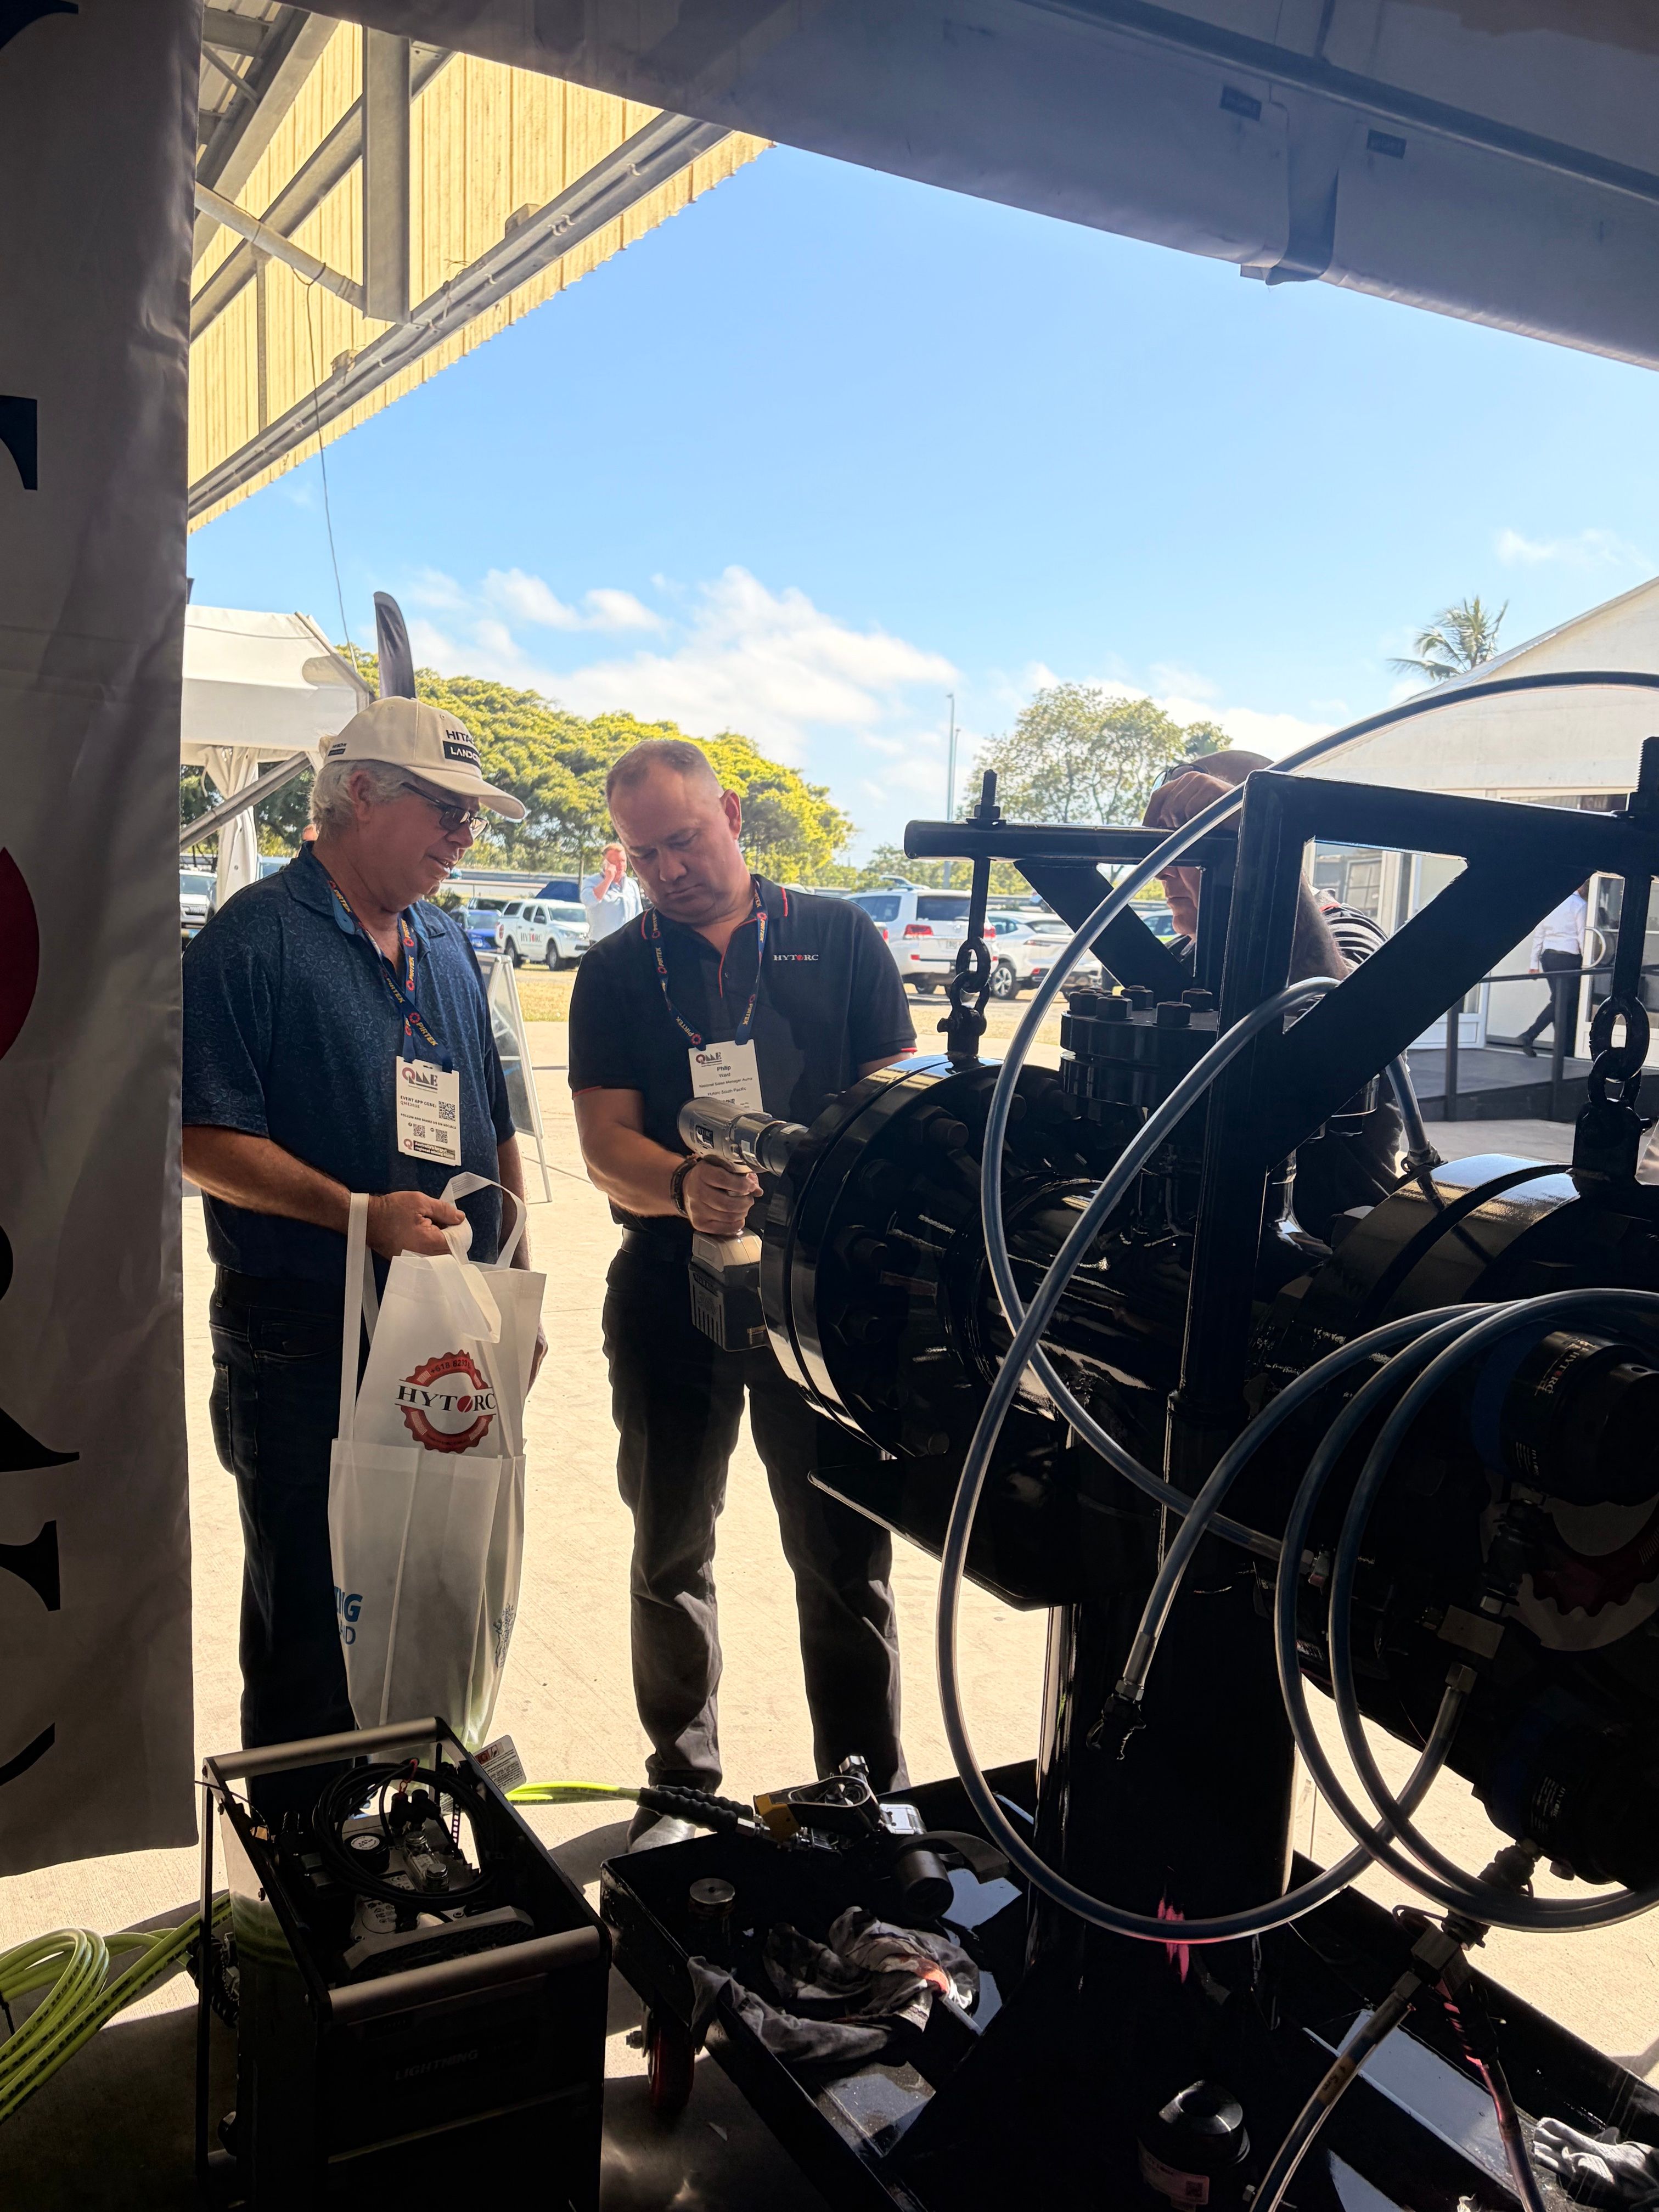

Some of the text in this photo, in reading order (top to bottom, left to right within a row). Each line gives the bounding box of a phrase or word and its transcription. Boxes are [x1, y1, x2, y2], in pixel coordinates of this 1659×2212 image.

[446, 729, 473, 744] HITA
[520, 932, 543, 943] HYTORC
[655, 947, 664, 966] PIRTEK
[386, 977, 405, 1004] PIRTEK
[742, 1003, 753, 1026] PIRTEK
[416, 1022, 438, 1047] PIRTEK
[676, 1016, 695, 1037] PIRTEK
[695, 1052, 722, 1065] QME
[402, 1067, 438, 1087] QME
[430, 1362, 451, 1374] +618
[1544, 1351, 1581, 1395] HYTORC
[396, 1385, 497, 1413] HYTORC
[395, 2048, 479, 2082] LIGHTNING
